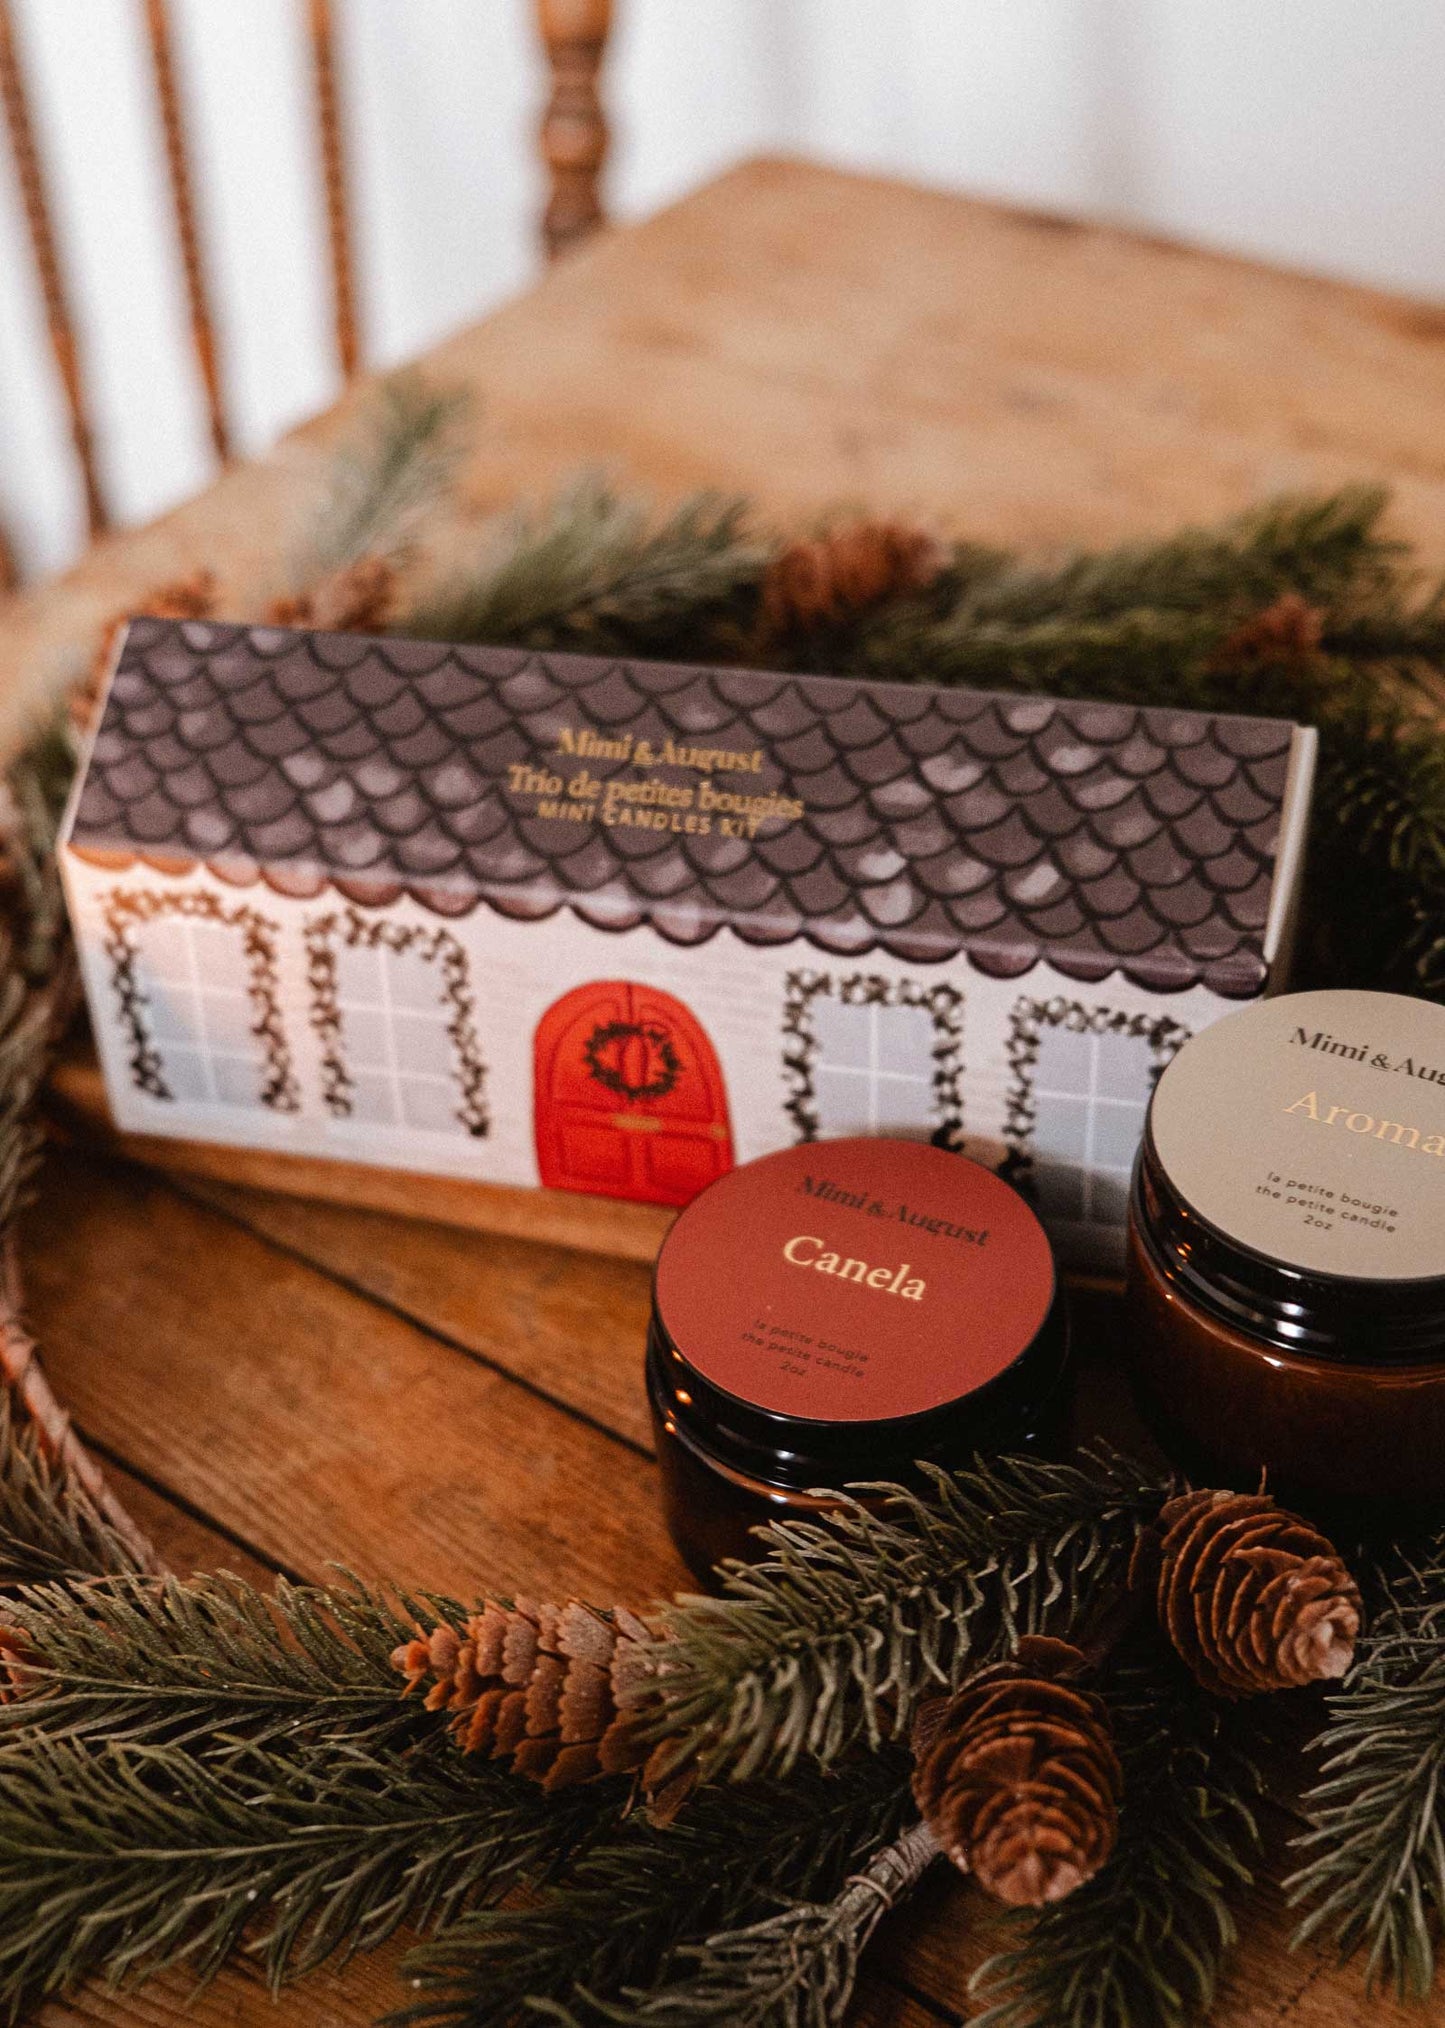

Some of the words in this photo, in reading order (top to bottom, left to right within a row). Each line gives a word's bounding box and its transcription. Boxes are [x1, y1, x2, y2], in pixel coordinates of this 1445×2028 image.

[556, 728, 632, 762] Mimi
[653, 737, 764, 775] August
[507, 763, 563, 797] Trio
[567, 769, 602, 800] de
[602, 778, 695, 812] petites
[699, 780, 805, 822] bougies
[602, 805, 712, 836] CANDLES
[1289, 1027, 1369, 1062] Mimi
[1369, 1053, 1391, 1072] &
[798, 1175, 869, 1210] Mimi
[887, 1204, 991, 1247] August
[1255, 1184, 1282, 1200] the
[1286, 1194, 1336, 1216] petite
[1340, 1211, 1397, 1234] candle
[1267, 1171, 1282, 1184] la
[1286, 1178, 1335, 1199] petite
[1340, 1192, 1399, 1218] bougie
[1303, 1213, 1334, 1231] 2oz
[783, 1234, 928, 1301] Canela
[742, 1331, 765, 1346] the
[767, 1341, 811, 1361] petite
[815, 1357, 865, 1378] candle
[769, 1326, 812, 1345] petite
[817, 1340, 868, 1363] bougie
